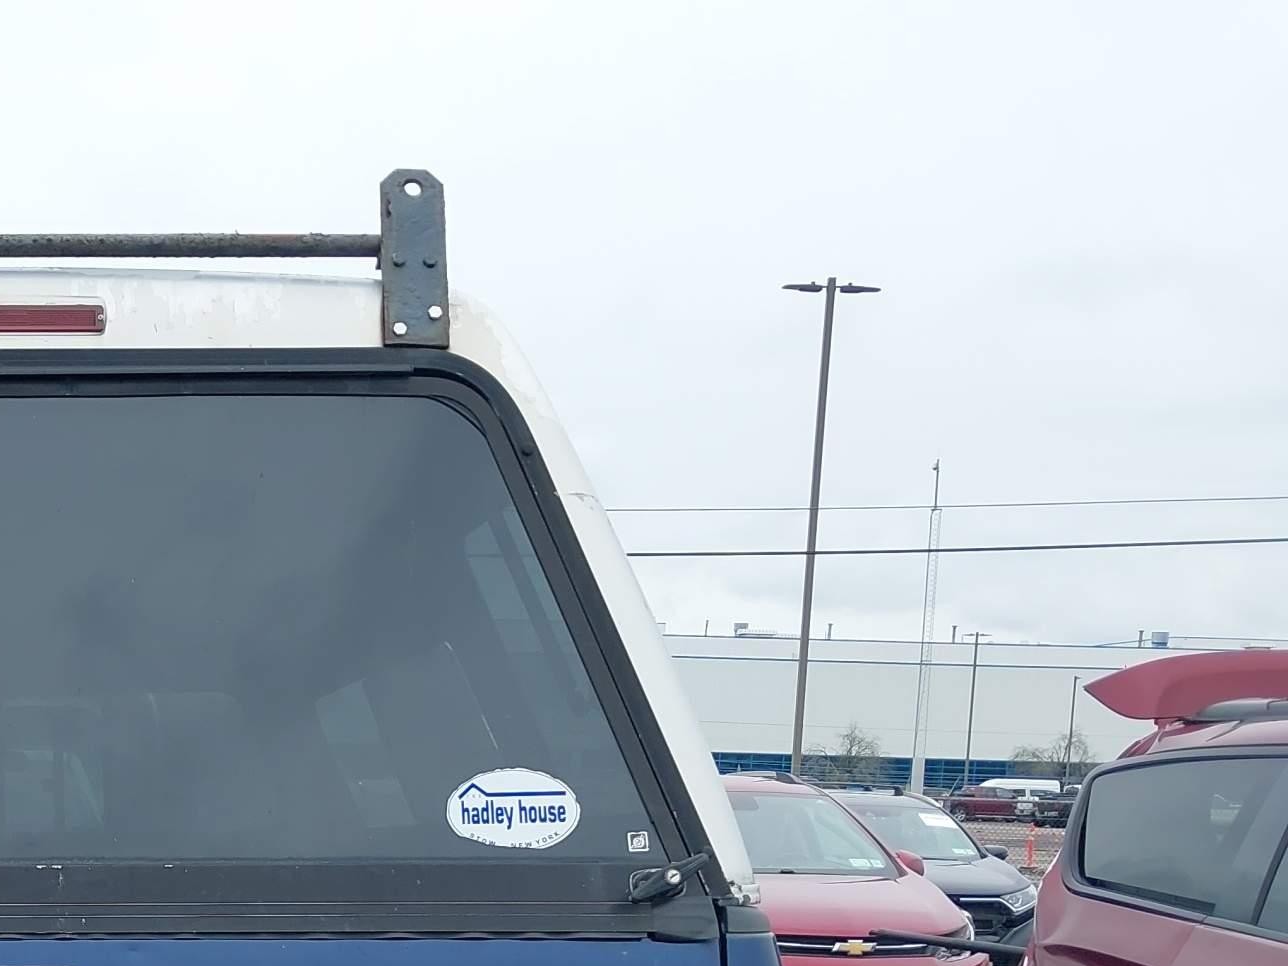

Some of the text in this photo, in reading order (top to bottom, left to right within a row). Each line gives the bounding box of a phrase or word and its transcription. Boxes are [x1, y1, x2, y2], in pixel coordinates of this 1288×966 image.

[461, 799, 567, 830] hadley house
[535, 832, 561, 845] YORK
